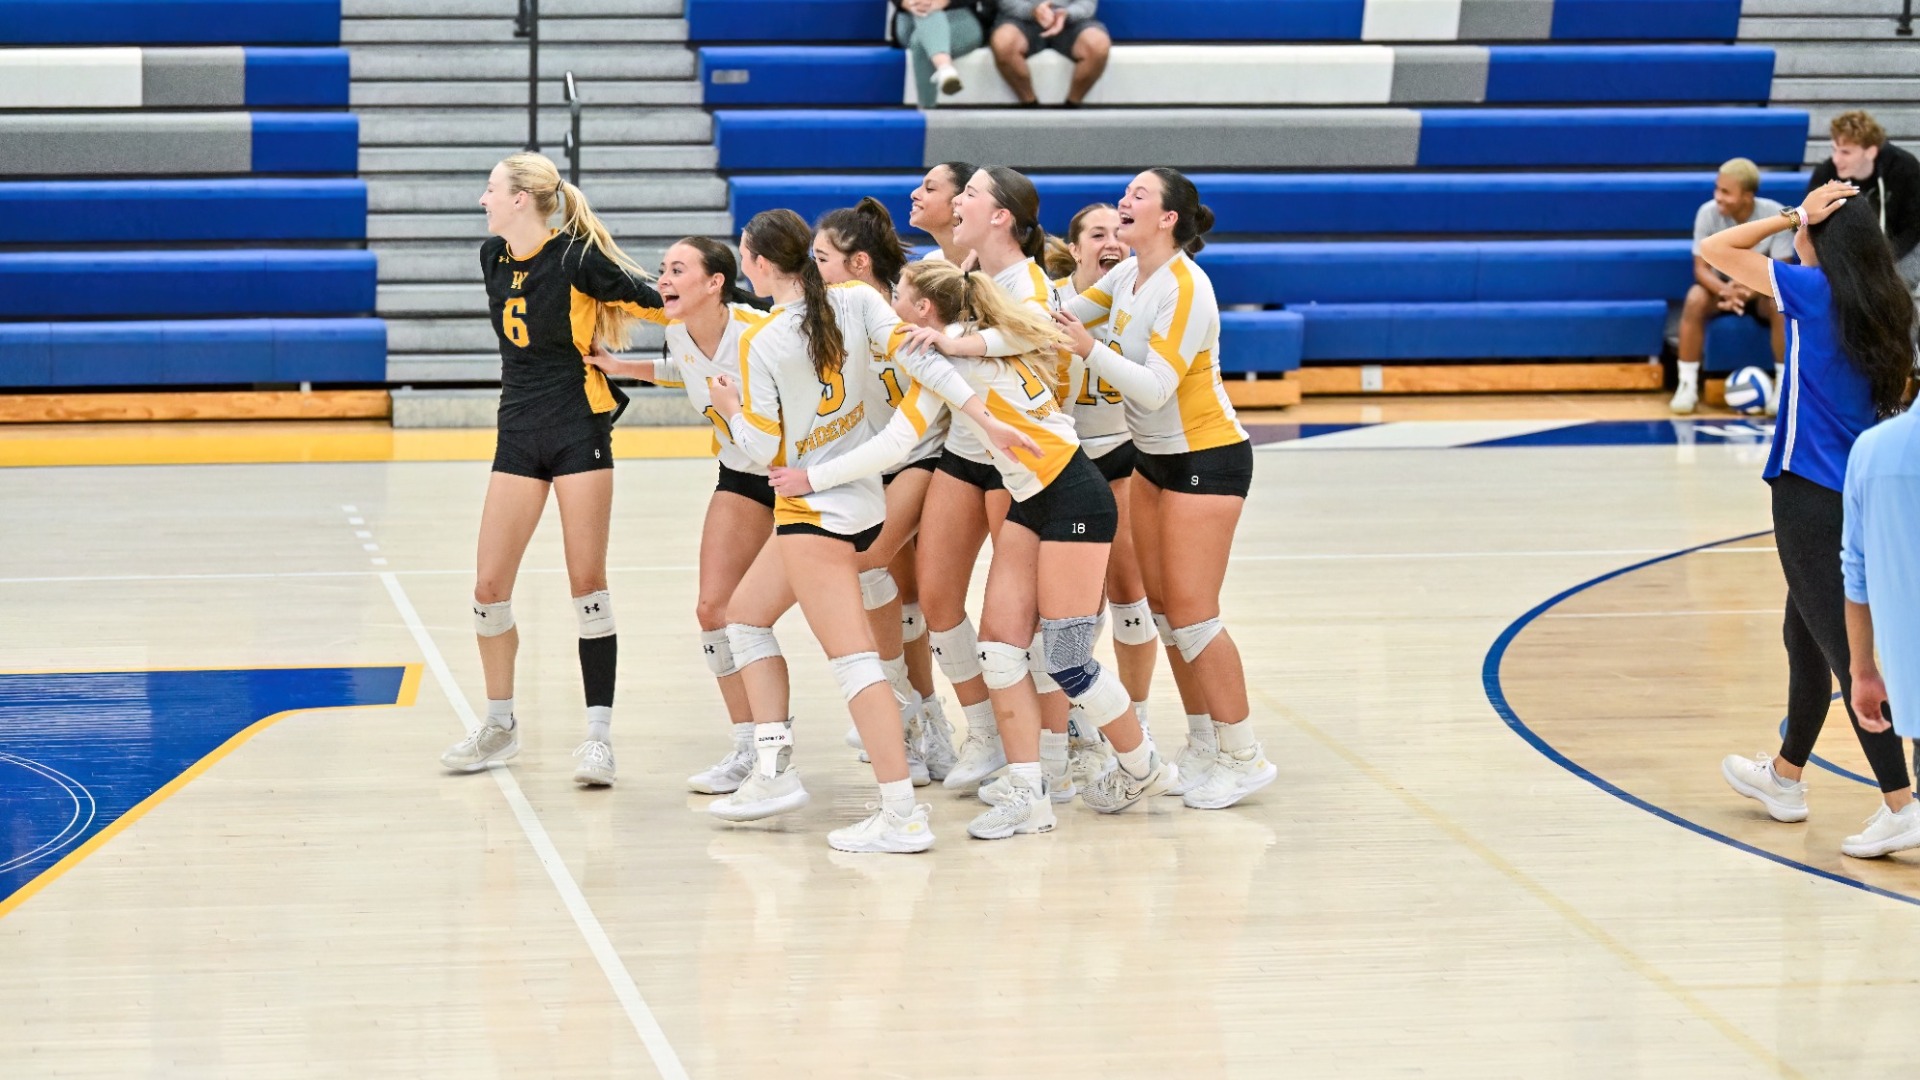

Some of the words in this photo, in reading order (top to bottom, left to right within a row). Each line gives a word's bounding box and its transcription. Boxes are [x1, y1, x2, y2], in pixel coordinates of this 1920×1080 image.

[502, 296, 531, 349] 6
[1190, 475, 1199, 486] 9
[1071, 522, 1086, 534] 18
